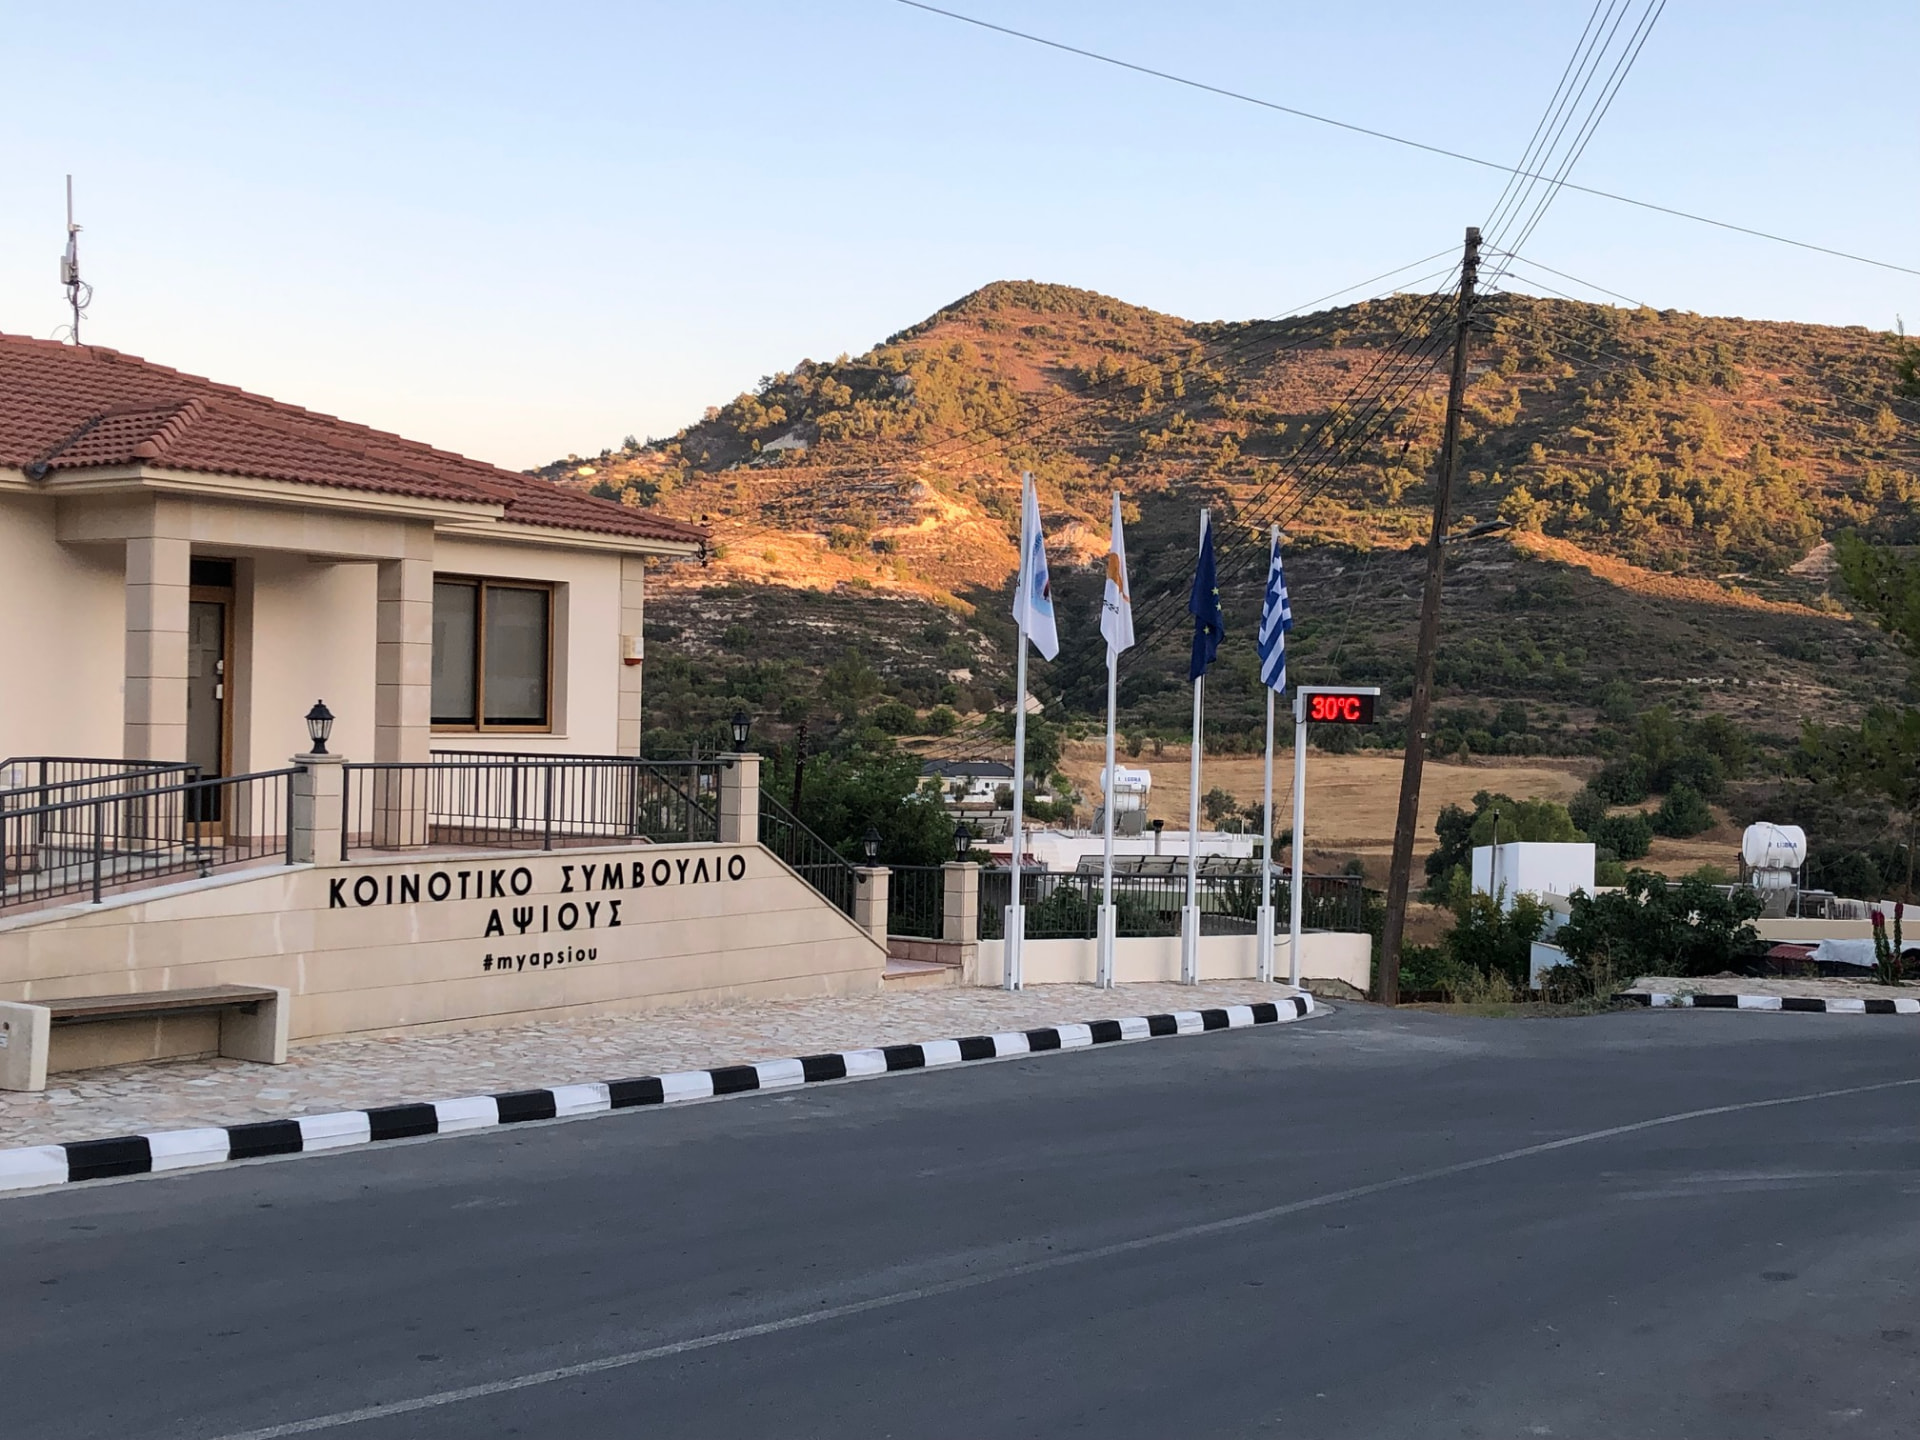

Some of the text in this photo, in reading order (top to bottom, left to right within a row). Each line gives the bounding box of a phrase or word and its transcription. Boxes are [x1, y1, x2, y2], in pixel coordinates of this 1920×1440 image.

[329, 854, 746, 908] ΚΟΙΝΟΤΙΚΟ ΣΥΜΒΟΥΛΙΟ
[484, 899, 622, 937] ΑΨΙΟΥΣ
[483, 947, 598, 973] #myapsiou
